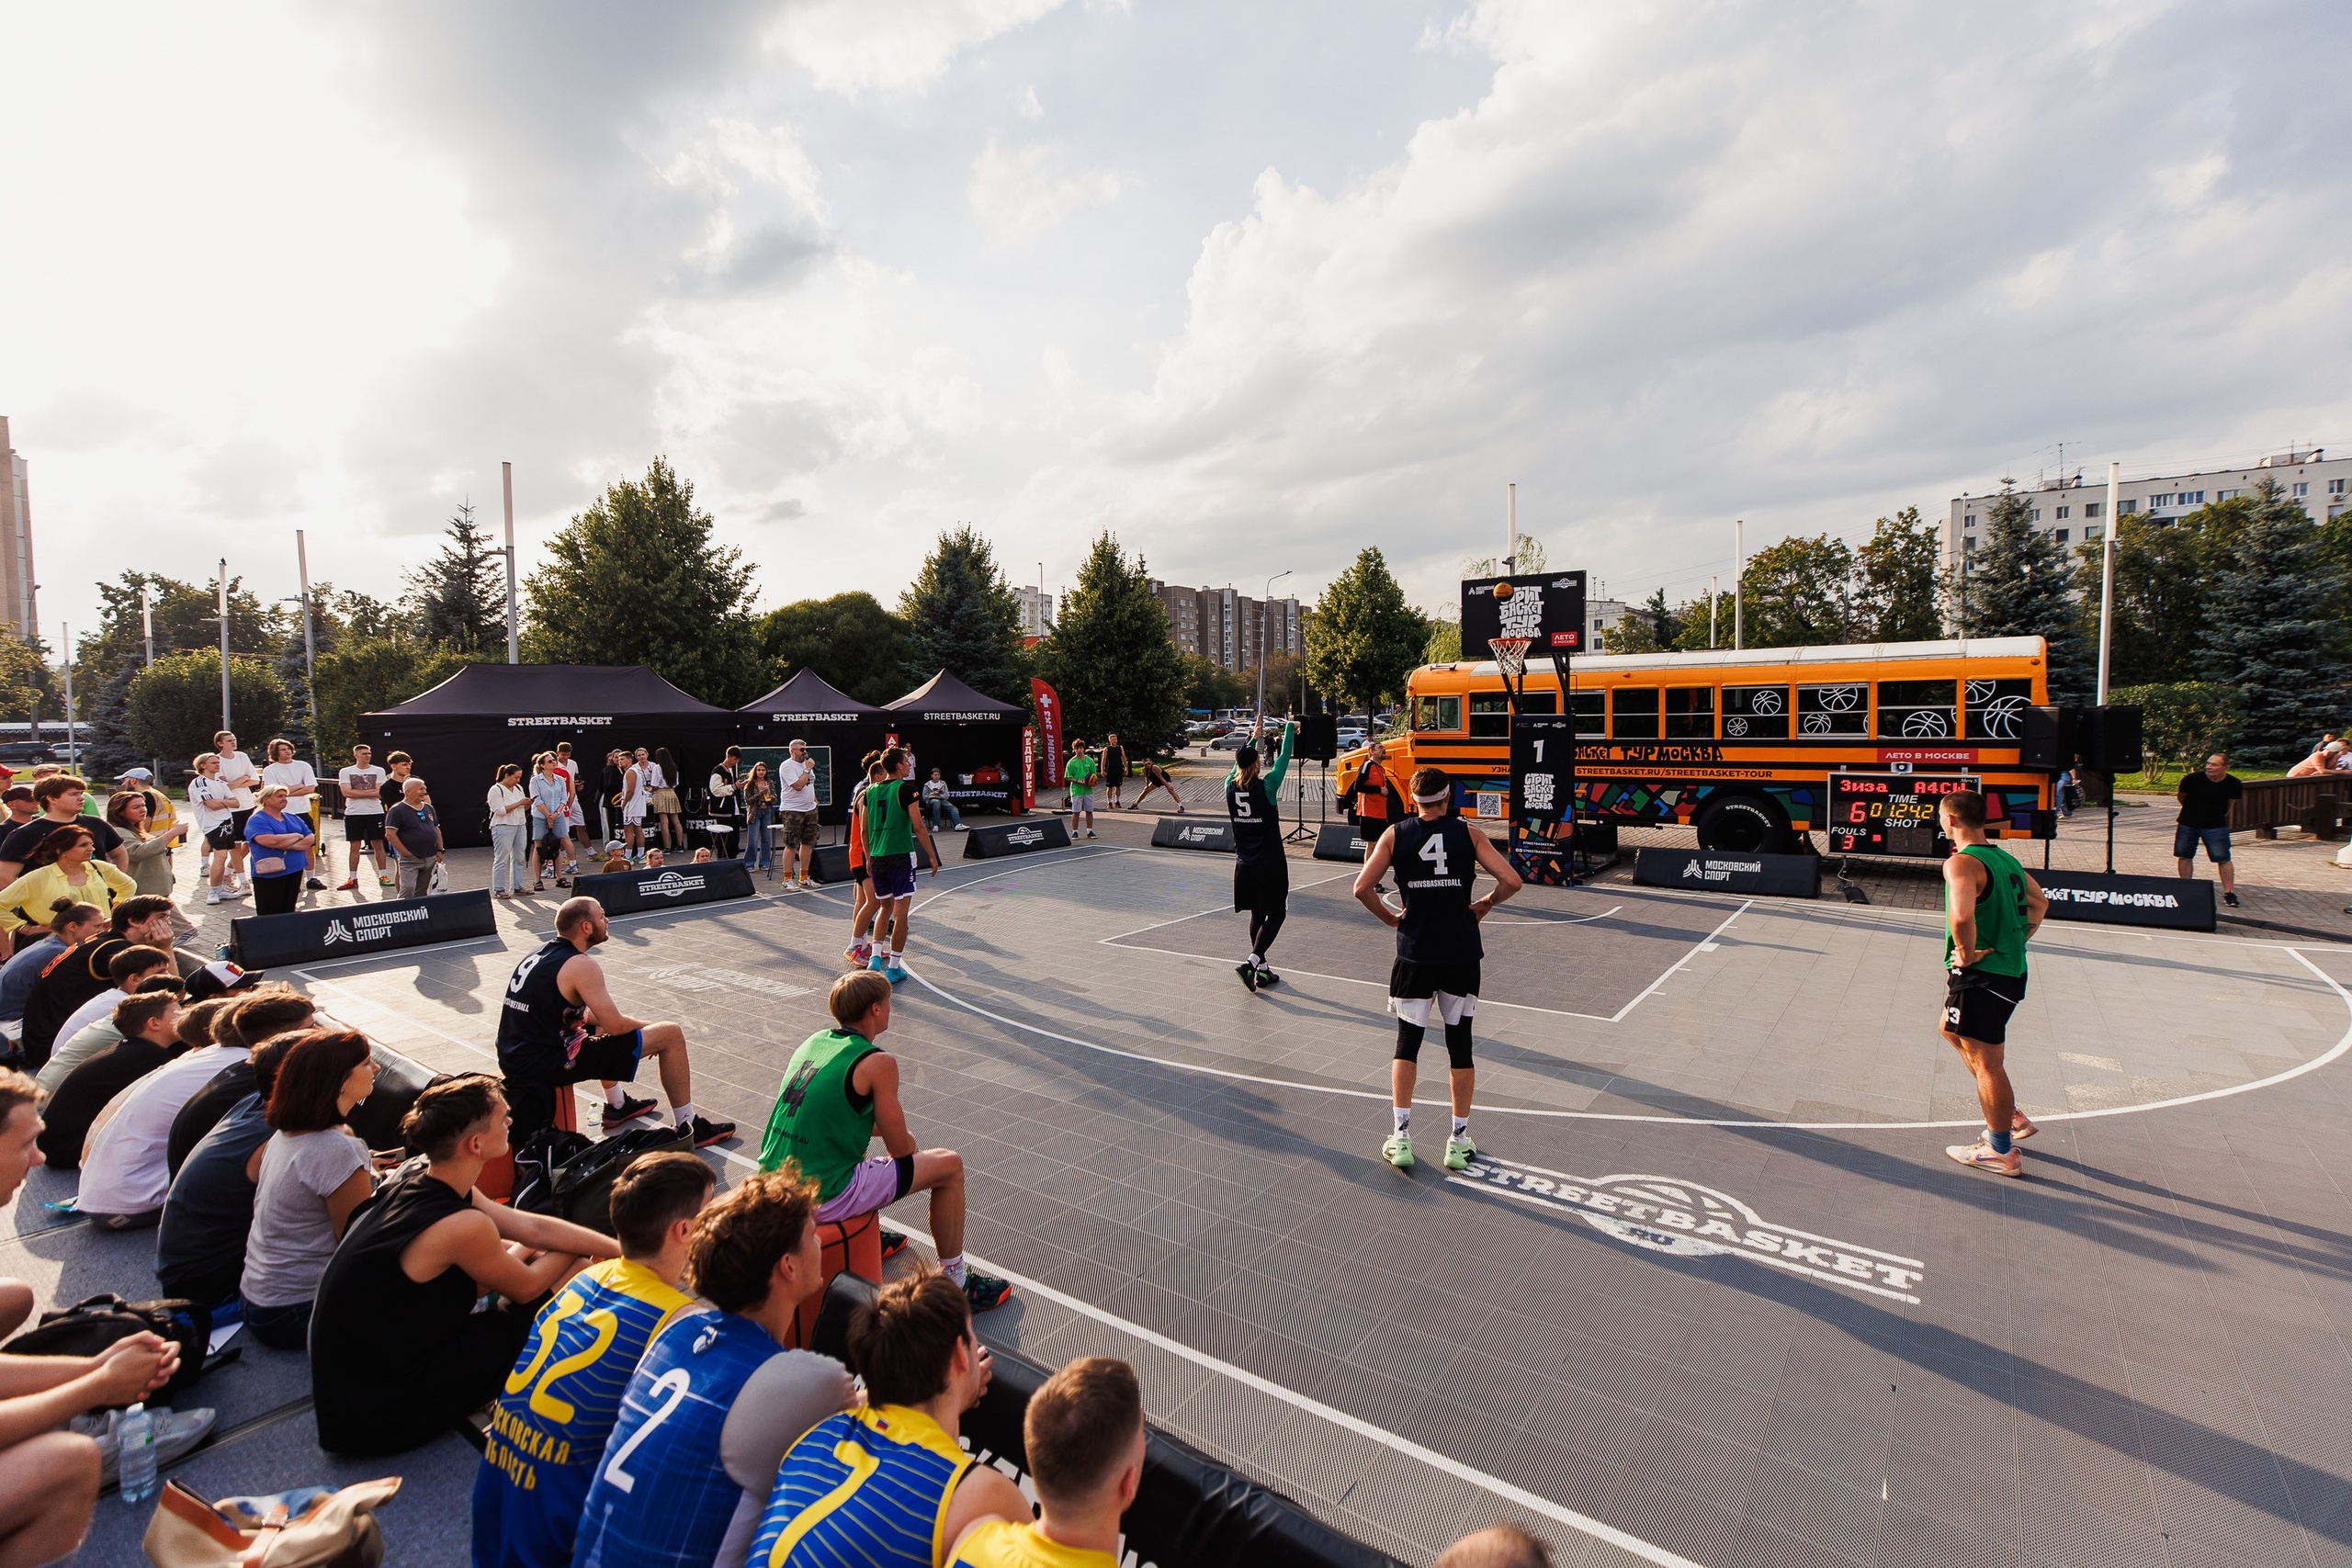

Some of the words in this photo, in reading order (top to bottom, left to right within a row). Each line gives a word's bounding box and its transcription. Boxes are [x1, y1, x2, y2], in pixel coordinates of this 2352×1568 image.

[1499, 601, 1544, 619] БАСКЕТ
[1499, 615, 1543, 629] ТУР
[1500, 627, 1542, 638] МОСКВА
[508, 716, 612, 726] STREETBASKET
[1533, 739, 1544, 763] 1
[1575, 746, 1611, 761] АСКЕТ
[1621, 746, 1656, 761] ТУР
[1656, 746, 1724, 761] МОСКВА
[1023, 729, 1033, 797] МЕДПУНКТ
[1524, 773, 1555, 785] СТРИТ
[1577, 767, 1773, 778] STREETBASKET.RU/STREETBASKET-TOUR
[1523, 784, 1555, 795] БАСКЕТ
[1839, 780, 1888, 793] Зиза
[1235, 792, 1251, 817] 5
[1524, 794, 1554, 803] ТУР
[1524, 801, 1554, 810] МОСКВА
[1888, 795, 1918, 804] TIME
[1725, 805, 1771, 828] STREETBASKET
[1849, 801, 1866, 823] 6
[1884, 818, 1921, 828] SHOT
[1192, 827, 1225, 836] МОСКОВСКИЙ
[1831, 827, 1867, 836] FOULS
[1841, 835, 1855, 850] 3
[1418, 833, 1449, 875] 4
[1705, 861, 1761, 873] МОСКОВСКИЙ
[1408, 878, 1462, 888] @KIVSBASKETBALL
[1704, 870, 1731, 882] СПОРТ
[639, 878, 705, 893] STREETBASKET
[2008, 873, 2029, 917] 2
[2041, 887, 2071, 901] СКЕТ
[2071, 889, 2109, 904] ТУР
[2108, 892, 2179, 908] МОСКВА
[352, 906, 429, 929] МОСКОВСКИЙ
[356, 925, 392, 942] СПОРТ
[510, 953, 543, 993] 9
[1457, 1163, 1924, 1289] STREETBASKET
[603, 1367, 691, 1494] 2
